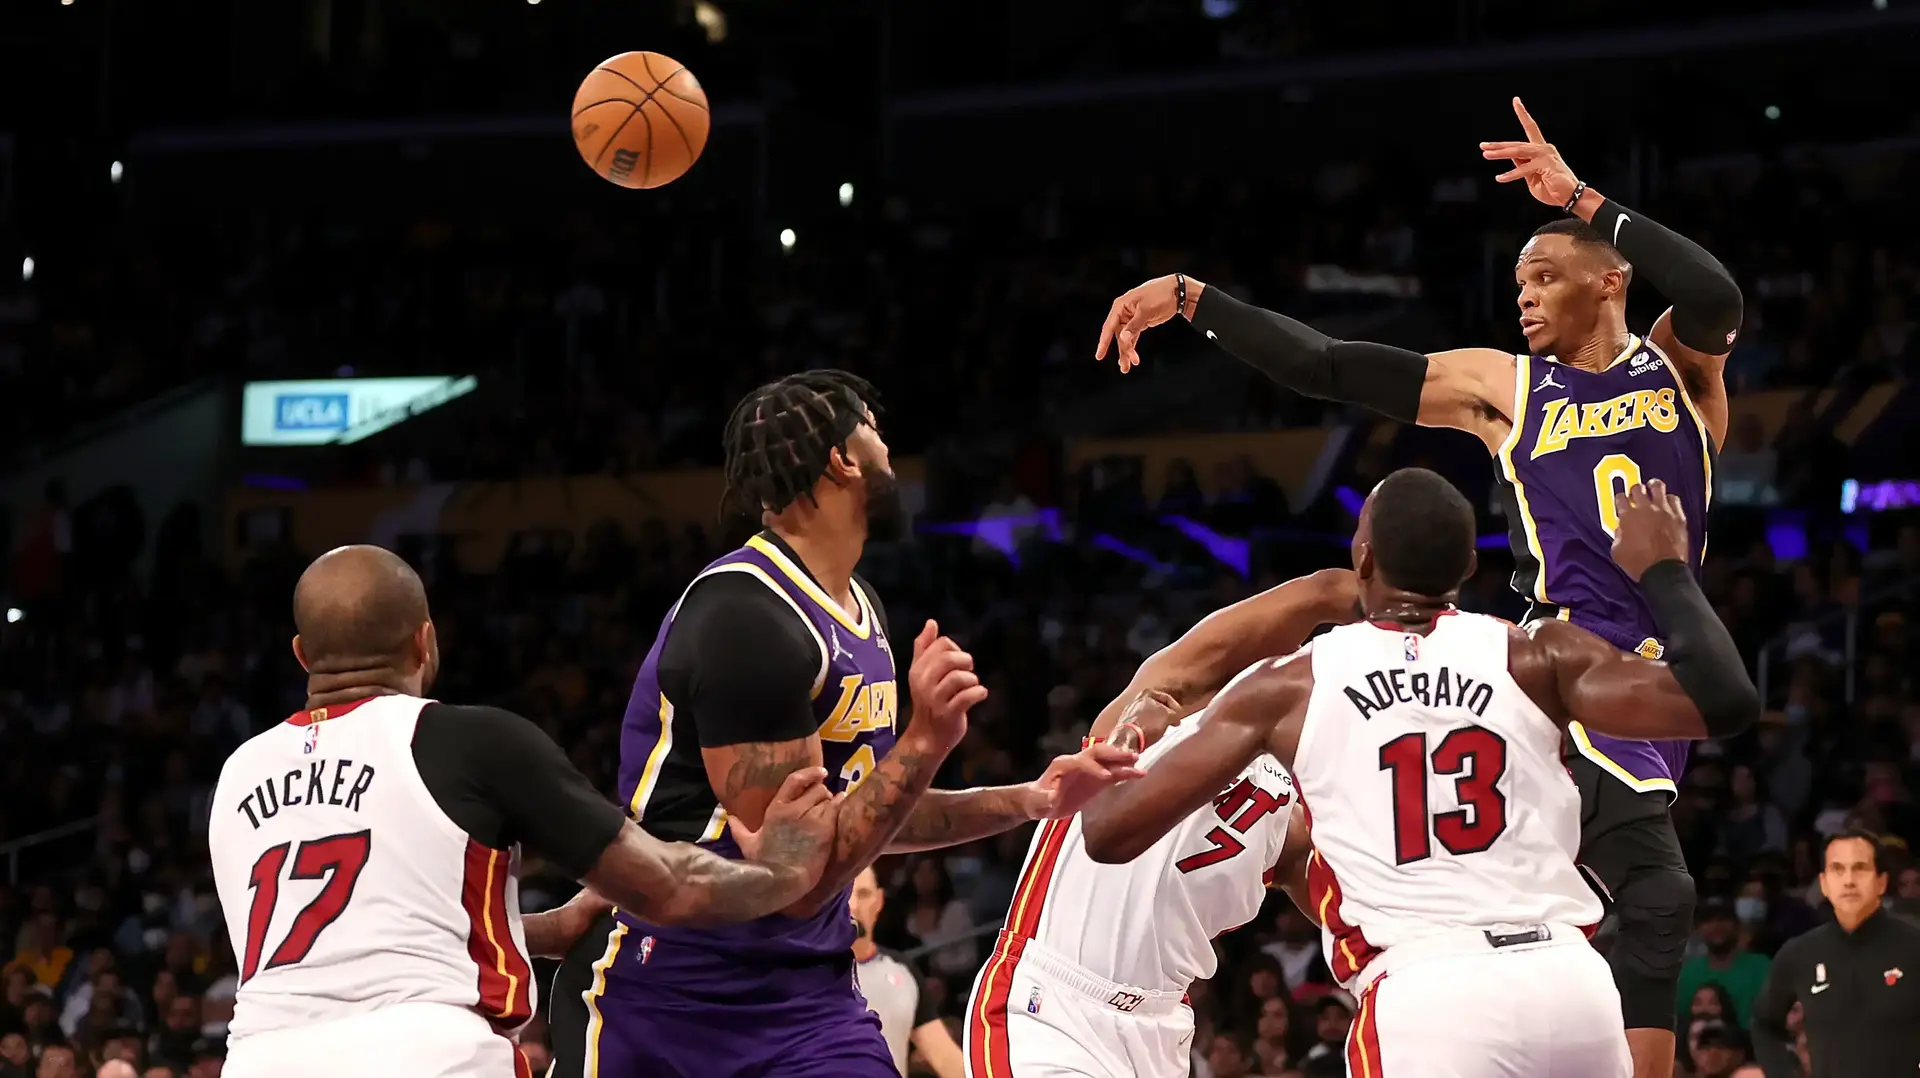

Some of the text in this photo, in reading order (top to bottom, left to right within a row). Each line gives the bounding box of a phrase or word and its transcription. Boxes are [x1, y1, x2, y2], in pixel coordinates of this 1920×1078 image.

[1628, 358, 1664, 378] bibigo
[1531, 388, 1679, 461] LAKERS
[1593, 454, 1642, 540] 0
[1343, 667, 1493, 720] ADEBAYO
[238, 759, 375, 829] TUCKER
[1263, 763, 1292, 786] UKG
[1379, 725, 1507, 866] 13
[1175, 825, 1246, 875] 7
[241, 829, 371, 982] 17
